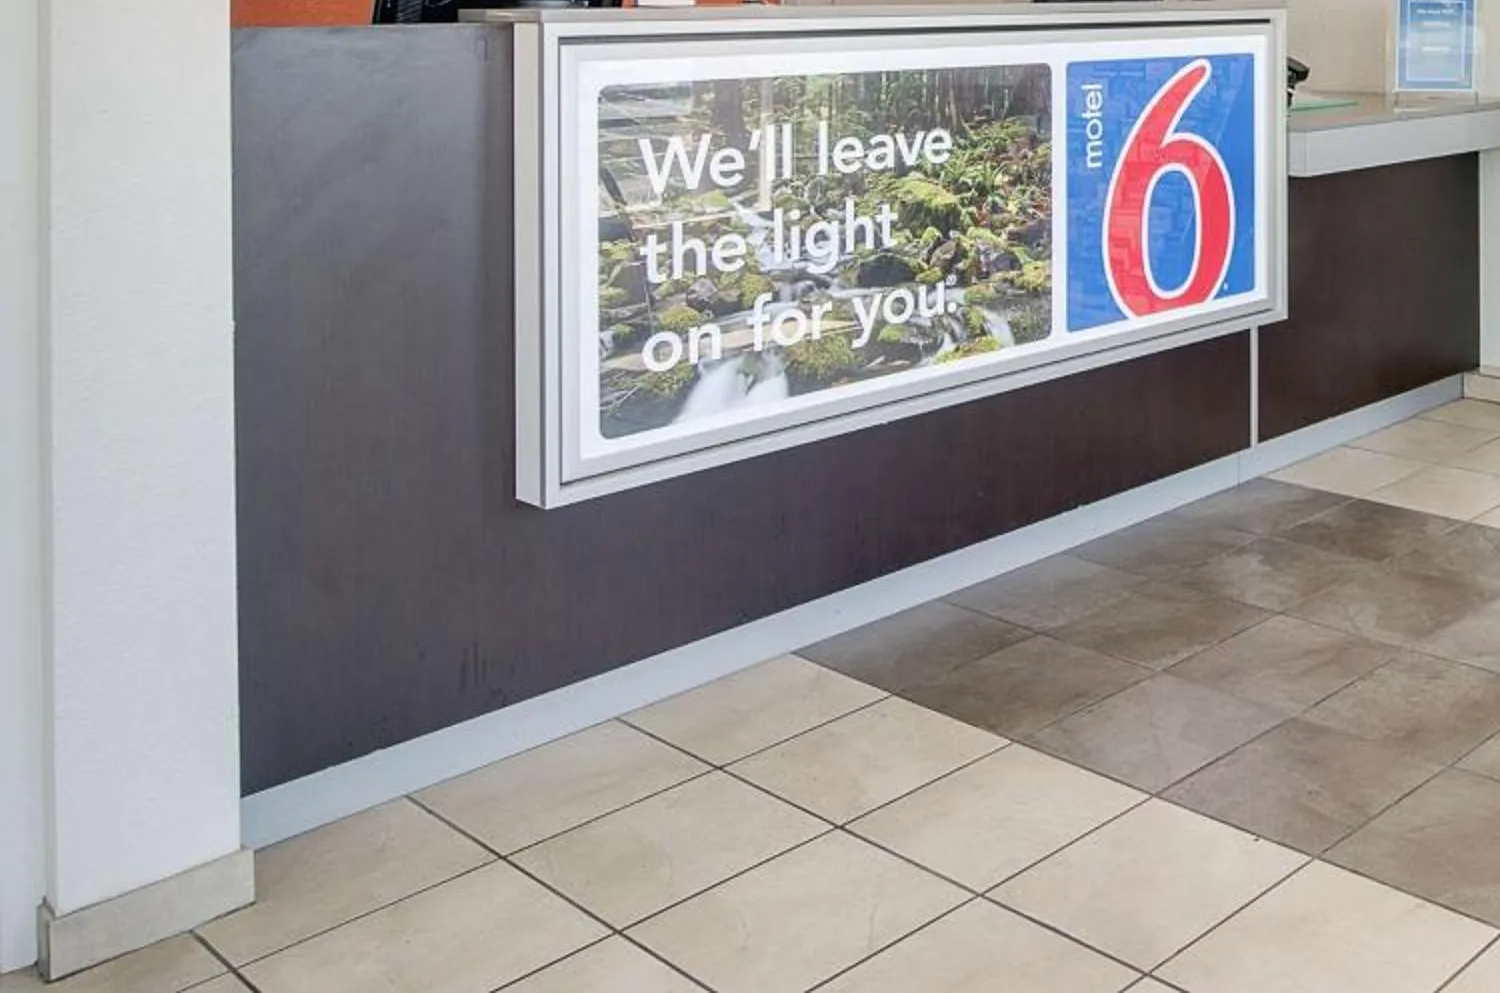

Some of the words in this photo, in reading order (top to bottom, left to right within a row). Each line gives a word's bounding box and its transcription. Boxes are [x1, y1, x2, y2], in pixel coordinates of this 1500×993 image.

[637, 124, 793, 193] We'll
[818, 121, 953, 175] leave
[1083, 82, 1104, 170] motel
[1104, 58, 1236, 319] 6
[640, 221, 746, 284] the
[773, 202, 899, 273] light
[640, 321, 722, 373] on
[747, 294, 833, 352] for
